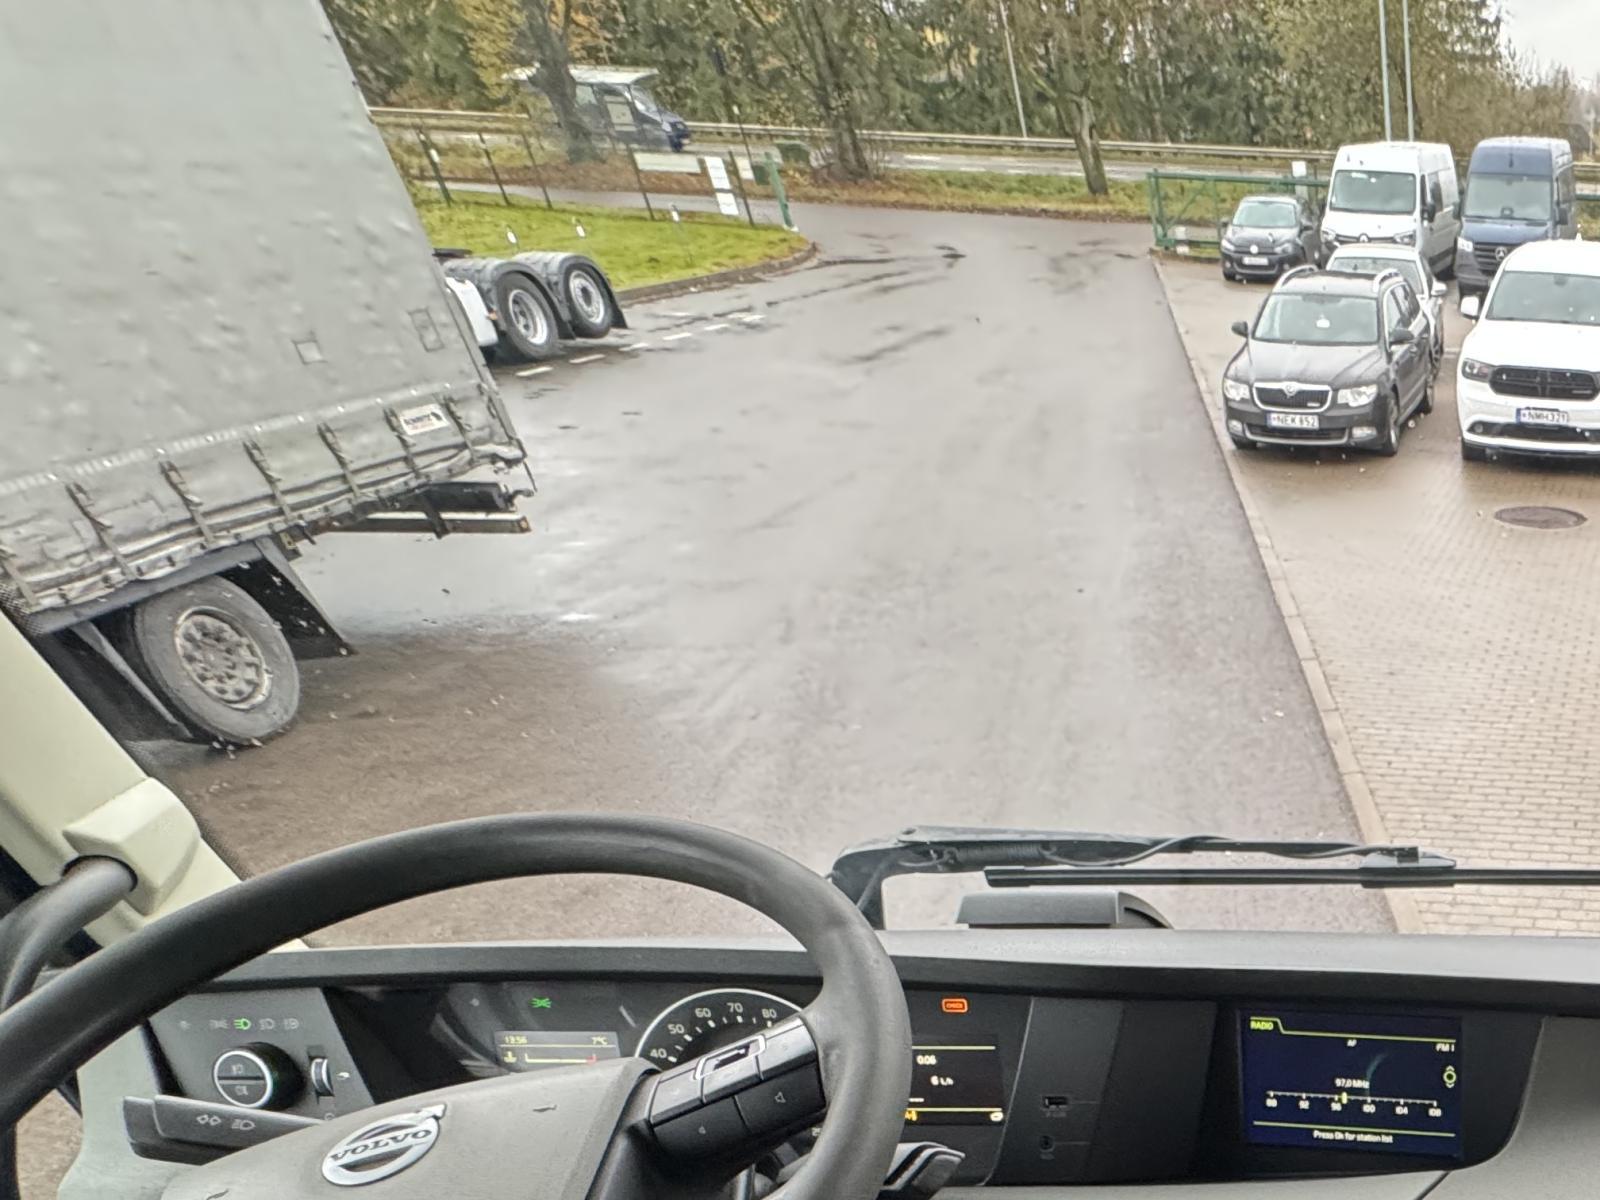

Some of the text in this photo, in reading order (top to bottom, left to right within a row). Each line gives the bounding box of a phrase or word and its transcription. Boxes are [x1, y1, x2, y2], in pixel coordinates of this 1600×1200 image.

[694, 1007, 712, 1019] 60
[726, 1002, 744, 1014] 70
[761, 1008, 777, 1019] 80
[667, 1023, 685, 1035] 50
[1250, 1021, 1274, 1031] RADIO
[649, 1047, 667, 1059] 40
[1298, 1099, 1310, 1110] 92
[1362, 1104, 1376, 1114] 100
[1395, 1106, 1409, 1116] 104
[1313, 1129, 1334, 1140] Press
[1356, 1133, 1381, 1142] station
[330, 1129, 432, 1161] VOLVO
